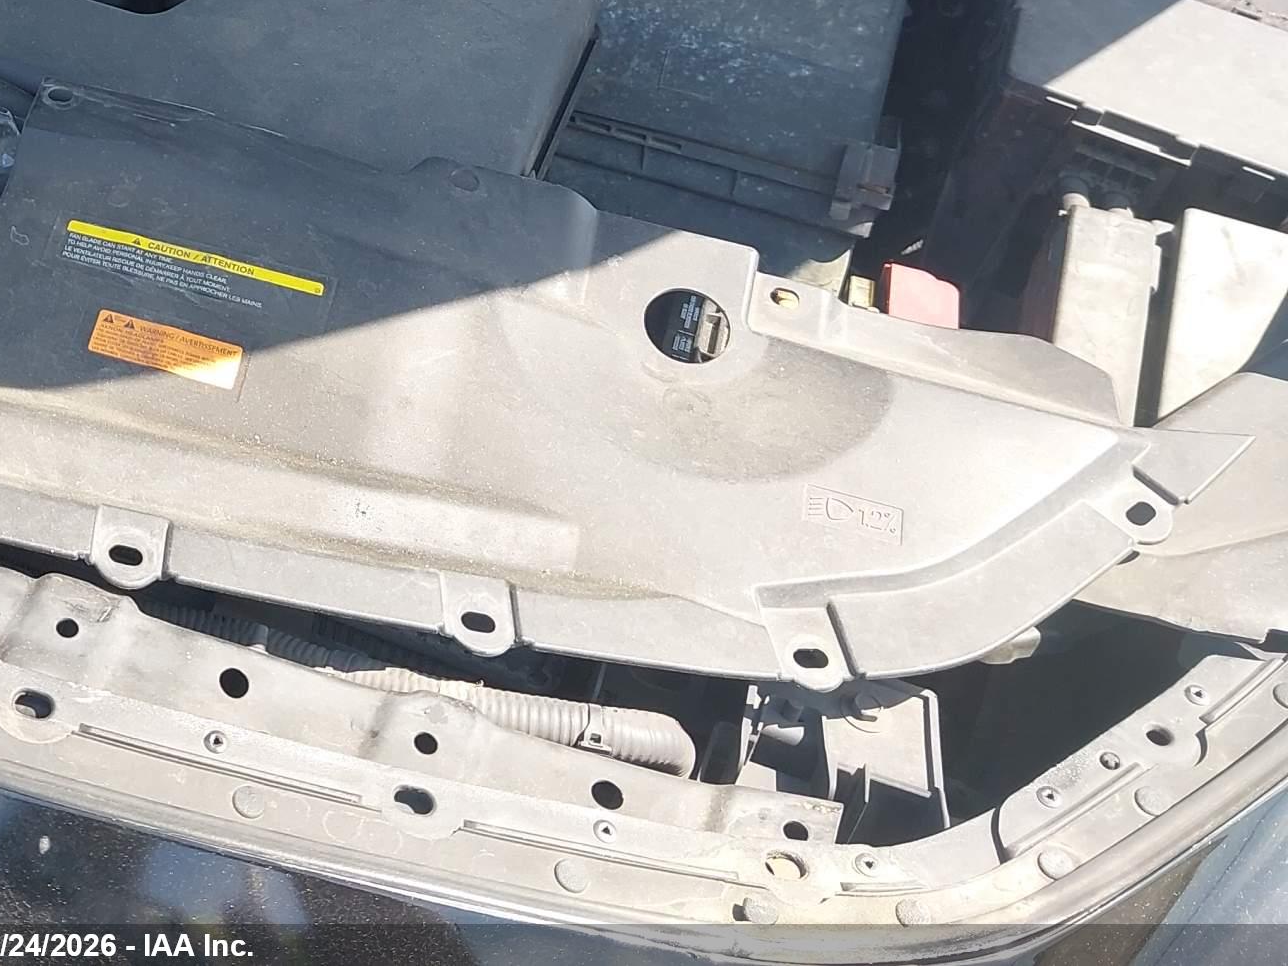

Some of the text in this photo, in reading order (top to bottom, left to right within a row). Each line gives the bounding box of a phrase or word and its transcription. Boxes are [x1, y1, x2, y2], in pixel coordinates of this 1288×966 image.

[62, 250, 80, 260] POUR
[76, 240, 92, 248] HELP
[112, 249, 143, 262] PERSONAL
[148, 242, 191, 259] CAUTION
[202, 255, 255, 275] ATTENTION
[186, 276, 201, 285] TOUT
